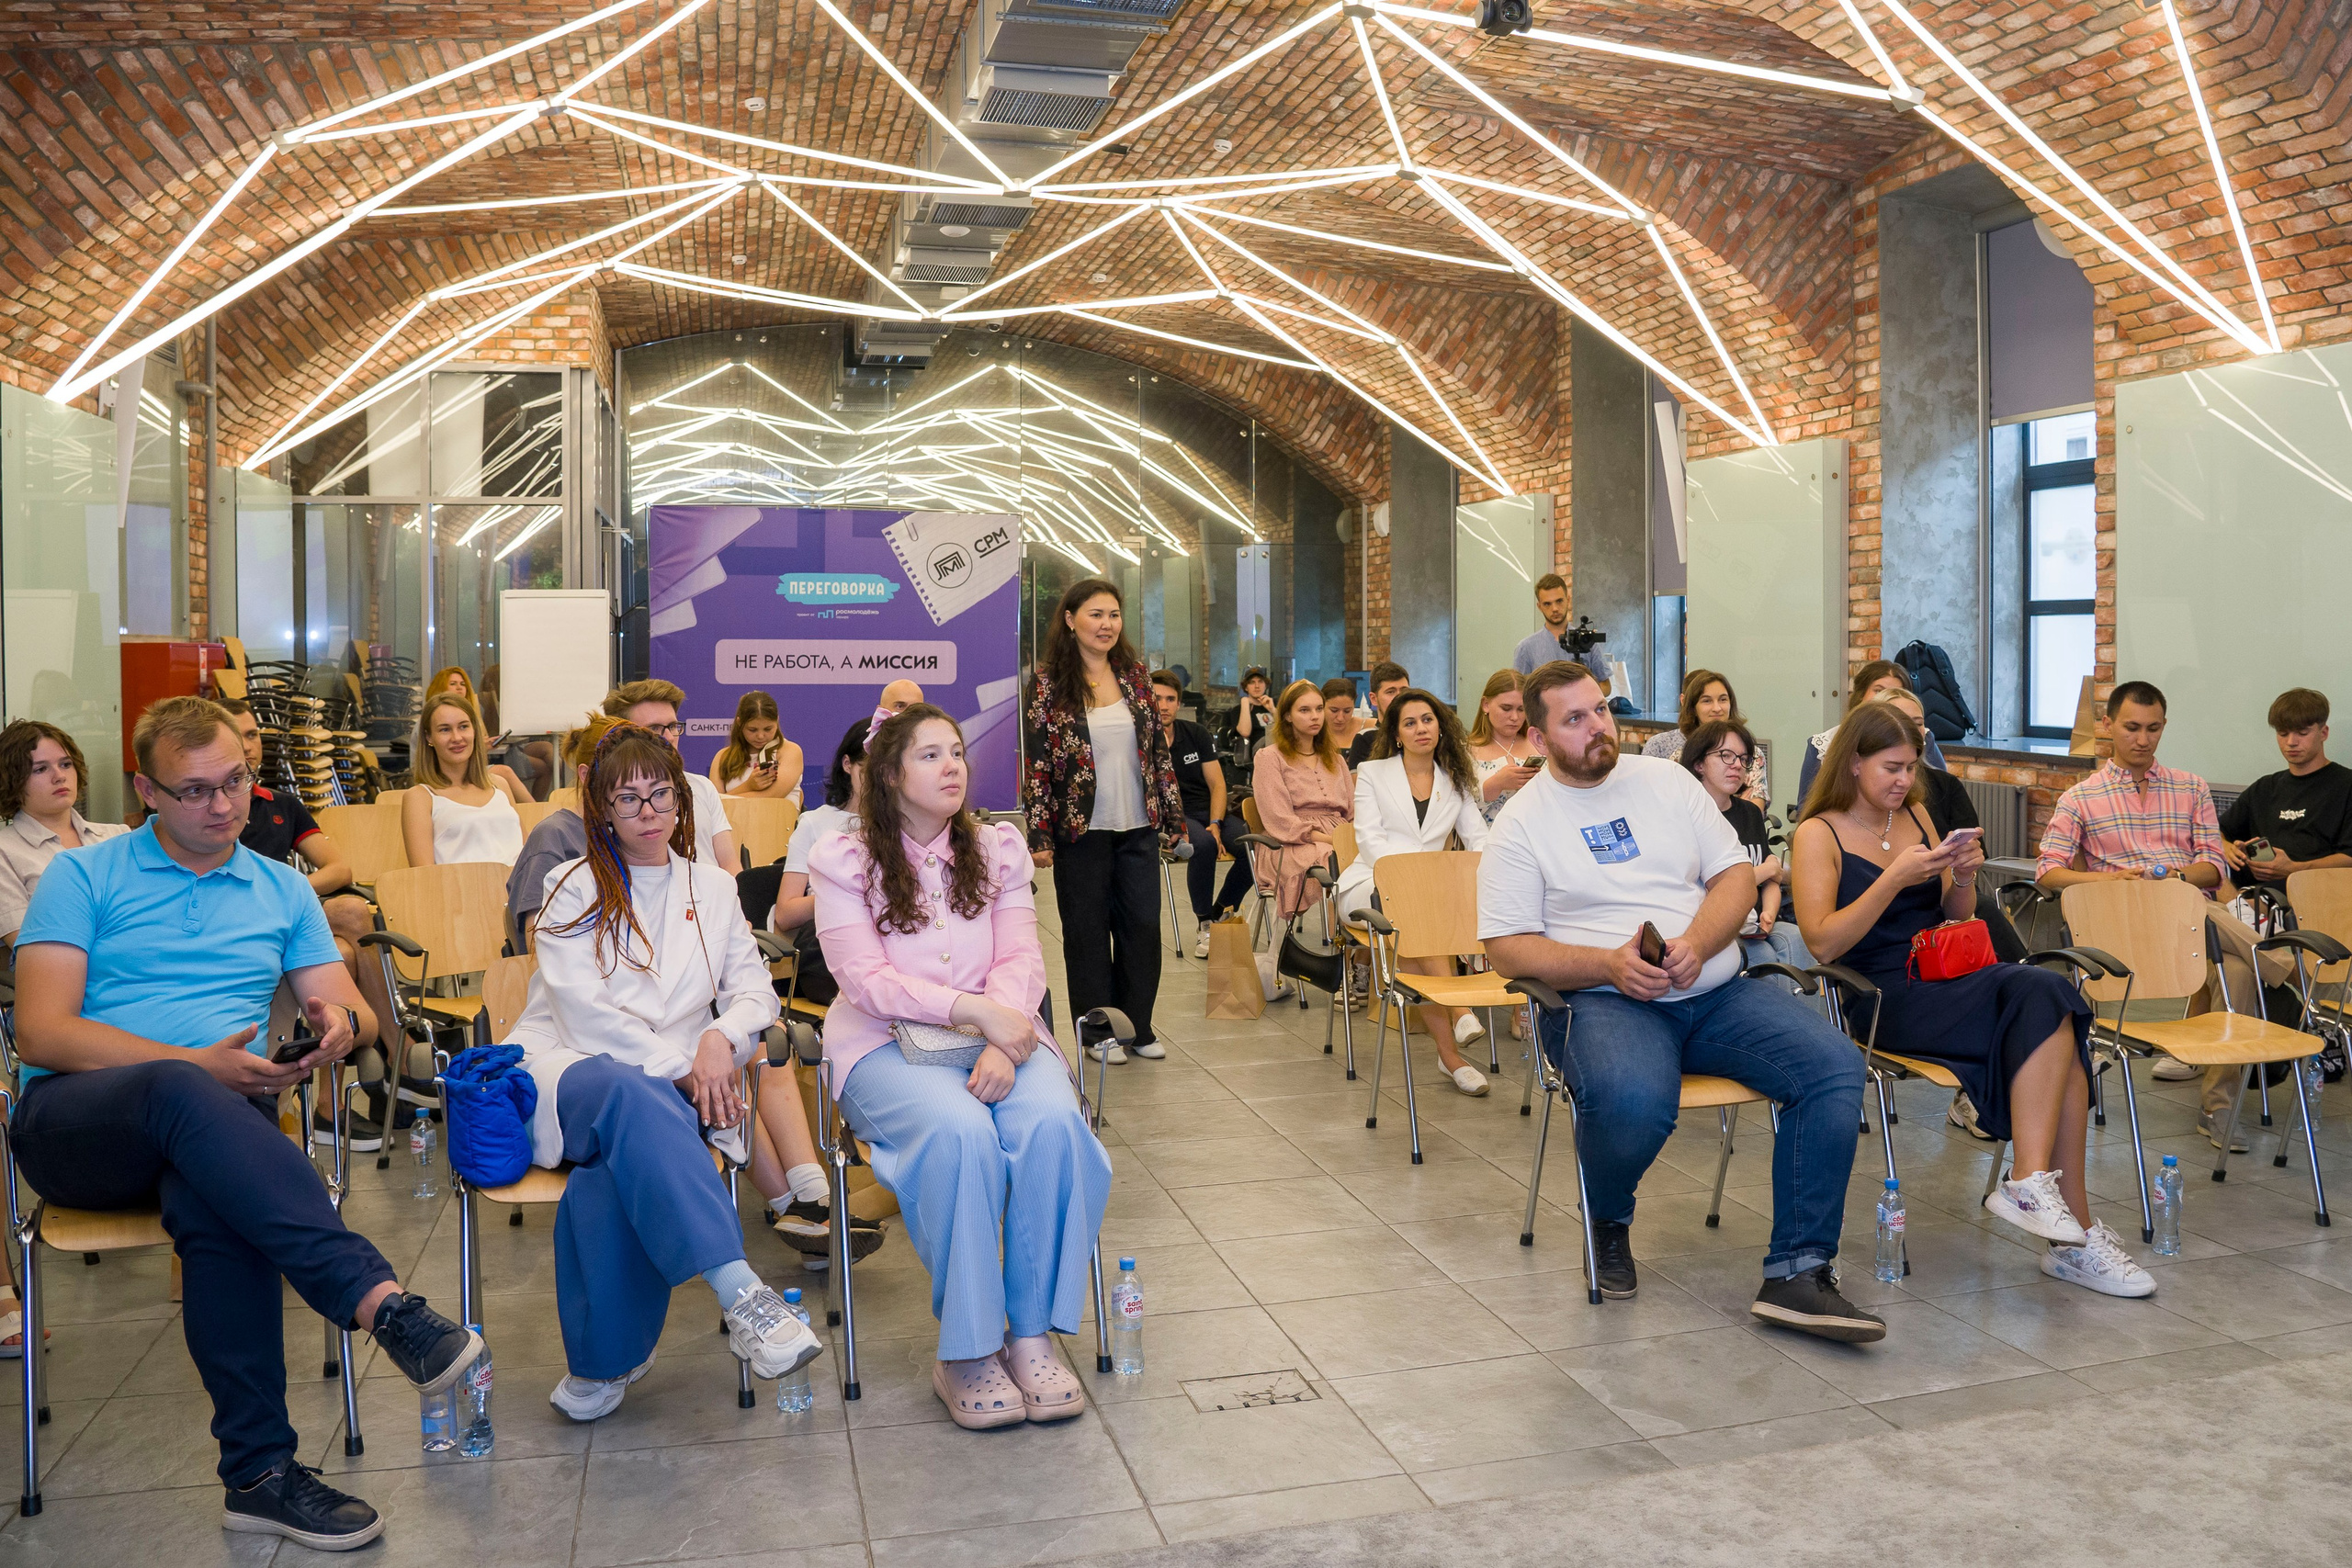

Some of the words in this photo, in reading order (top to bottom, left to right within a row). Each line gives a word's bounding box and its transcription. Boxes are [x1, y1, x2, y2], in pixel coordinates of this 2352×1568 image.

[789, 581, 885, 595] ПЕРЕГОВОРКА
[735, 655, 757, 669] НЕ
[764, 655, 835, 671] РАБОТА,
[841, 655, 853, 669] А
[858, 655, 938, 670] МИССИЯ
